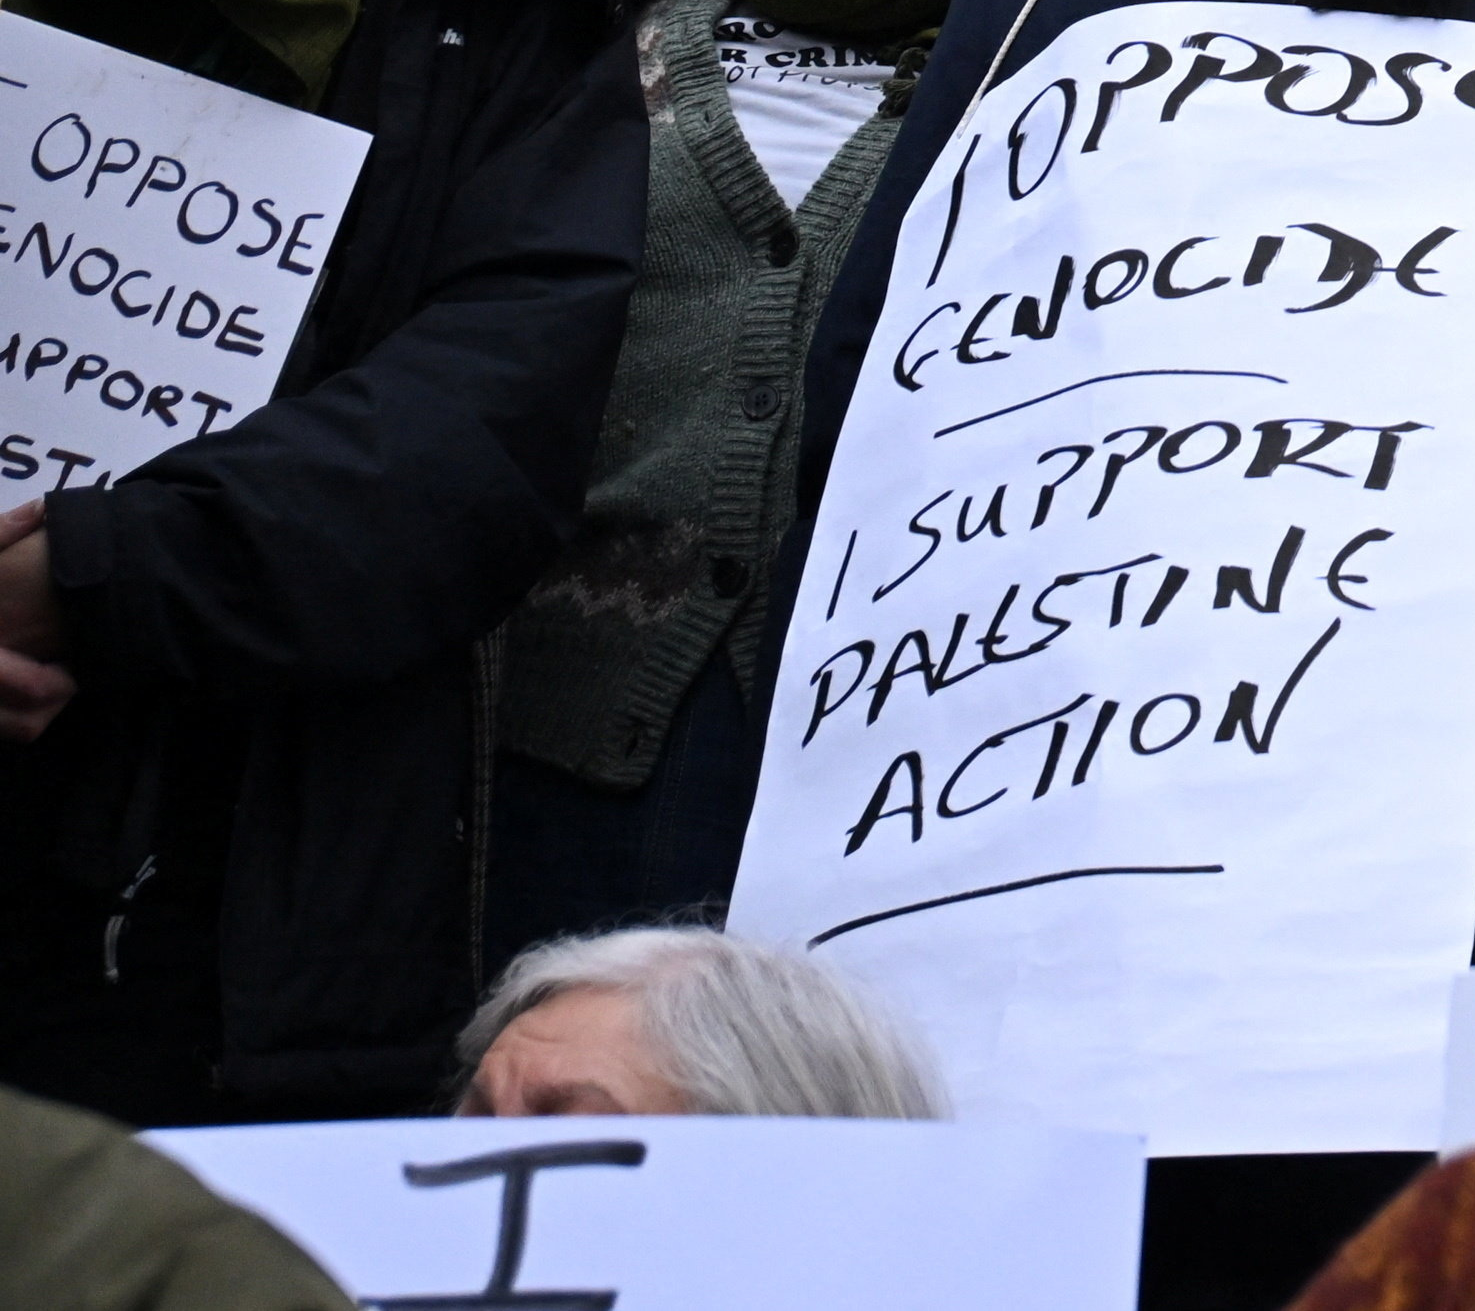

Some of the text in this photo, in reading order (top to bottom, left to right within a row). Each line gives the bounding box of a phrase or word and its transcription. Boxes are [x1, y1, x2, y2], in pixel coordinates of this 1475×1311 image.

[31, 113, 325, 276] OPPOSE
[926, 134, 981, 287] I
[893, 221, 1463, 392] GENOCIDE
[826, 420, 1435, 621] I SUPPORT
[802, 525, 1395, 747] PALESTINE
[843, 619, 1341, 857] ACTION
